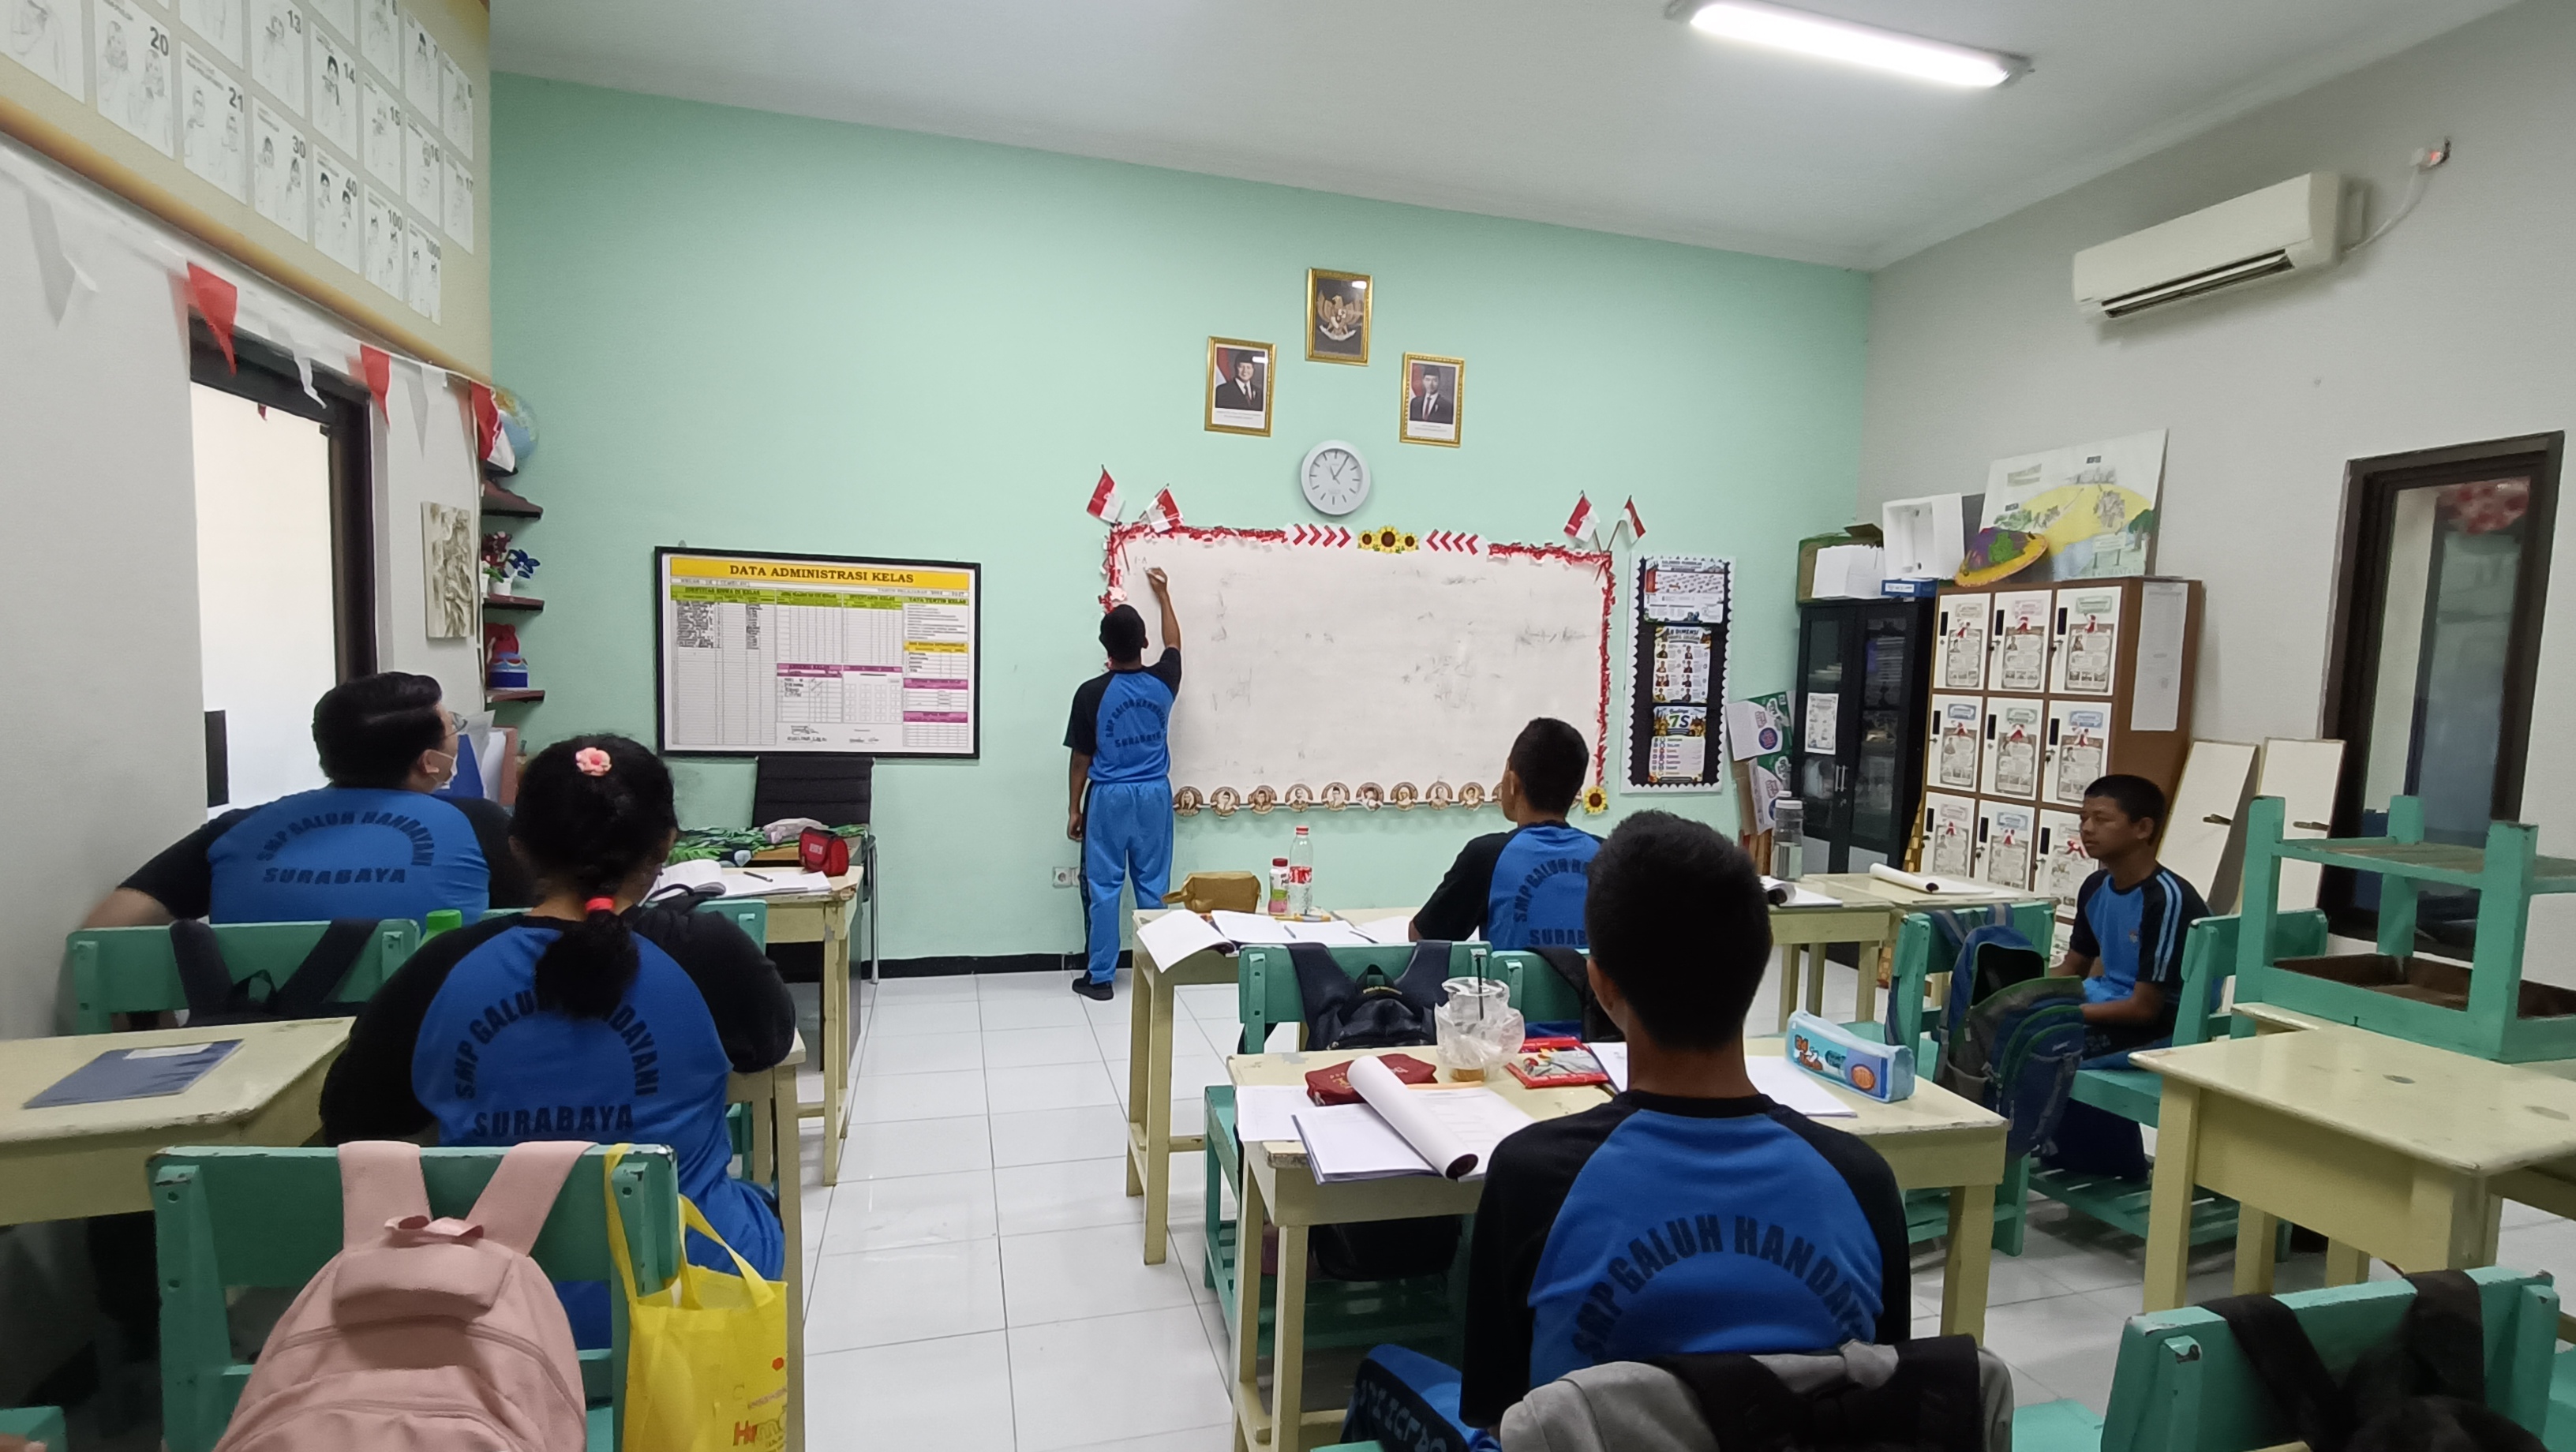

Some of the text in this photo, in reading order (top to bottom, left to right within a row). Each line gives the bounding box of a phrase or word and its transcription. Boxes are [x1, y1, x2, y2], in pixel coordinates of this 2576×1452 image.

[286, 9, 301, 34] 13
[150, 26, 169, 57] 20
[343, 62, 355, 84] 14
[228, 86, 244, 113] 21
[390, 106, 401, 126] 15
[291, 135, 306, 159] 30
[346, 177, 358, 197] 40
[388, 209, 402, 231] 100
[729, 564, 914, 583] DATA ADMINISTRASI KELAS
[1106, 719, 1115, 738] SMP
[1669, 714, 1690, 728] 7S
[1114, 732, 1162, 748] SURABAYA
[256, 810, 435, 866] SMP GALUH HANDAYANI
[263, 867, 406, 885] SURABAYA
[1513, 858, 1569, 922] SMP GALUH
[1529, 928, 1589, 946] SURAB
[454, 1040, 480, 1100] SMP
[469, 989, 537, 1046] GALU
[473, 1103, 635, 1138] SURABAYA
[1571, 1281, 1623, 1362] SMP
[1608, 1214, 1724, 1295] GALUH
